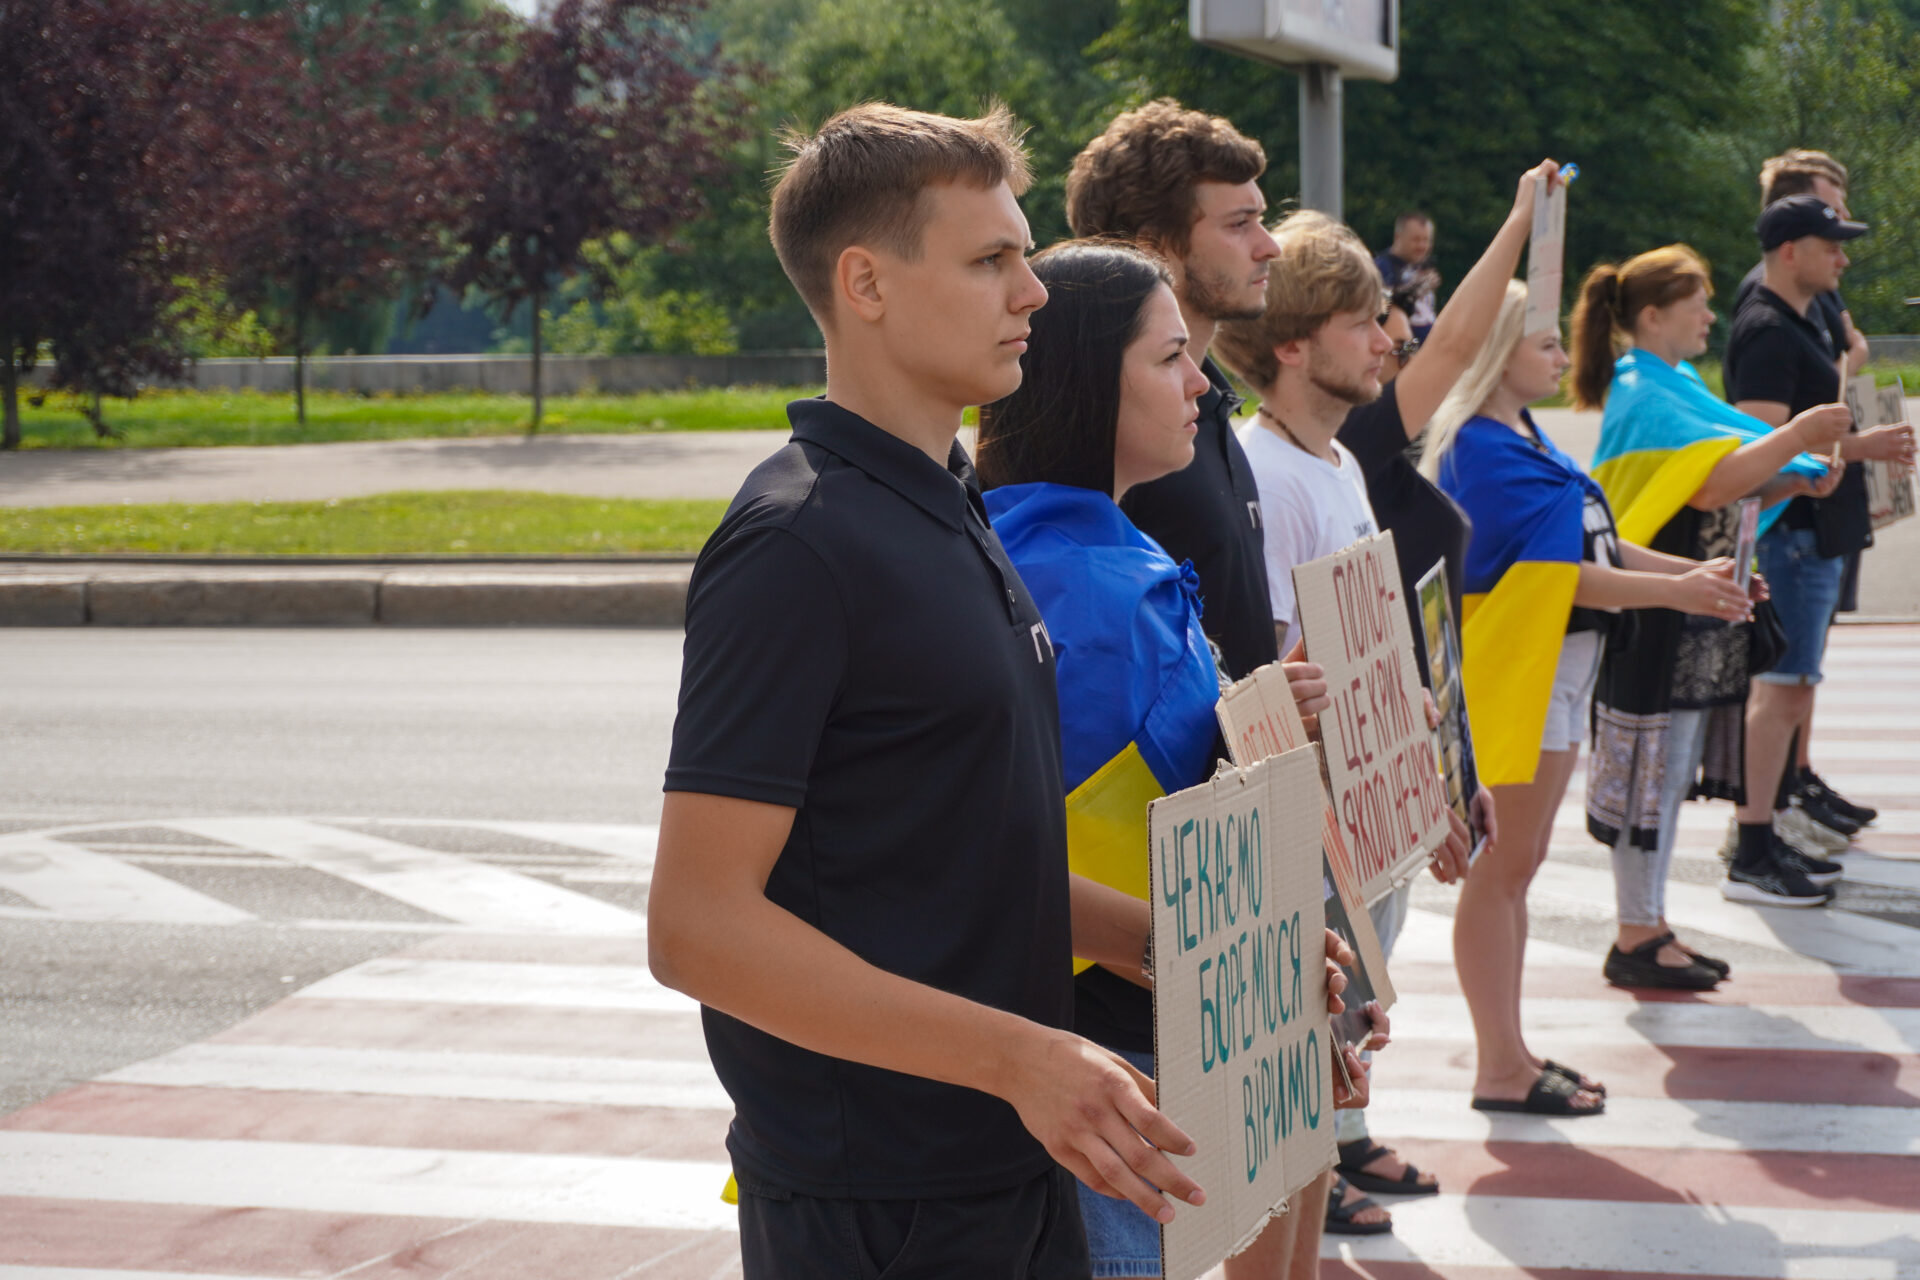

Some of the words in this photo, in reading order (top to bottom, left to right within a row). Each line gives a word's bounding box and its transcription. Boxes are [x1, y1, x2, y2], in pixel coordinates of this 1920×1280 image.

[1332, 550, 1396, 664] ПОЛОН-
[1334, 677, 1373, 776] ЦЕ
[1365, 644, 1415, 756] КРИК
[1161, 806, 1263, 956] ЧЕКАЄМО
[1343, 769, 1396, 888] ЯКОГО
[1388, 751, 1418, 855] НЕ
[1199, 910, 1303, 1074] БОРЕМОСЯ
[1243, 1027, 1321, 1184] ВІРИМО
